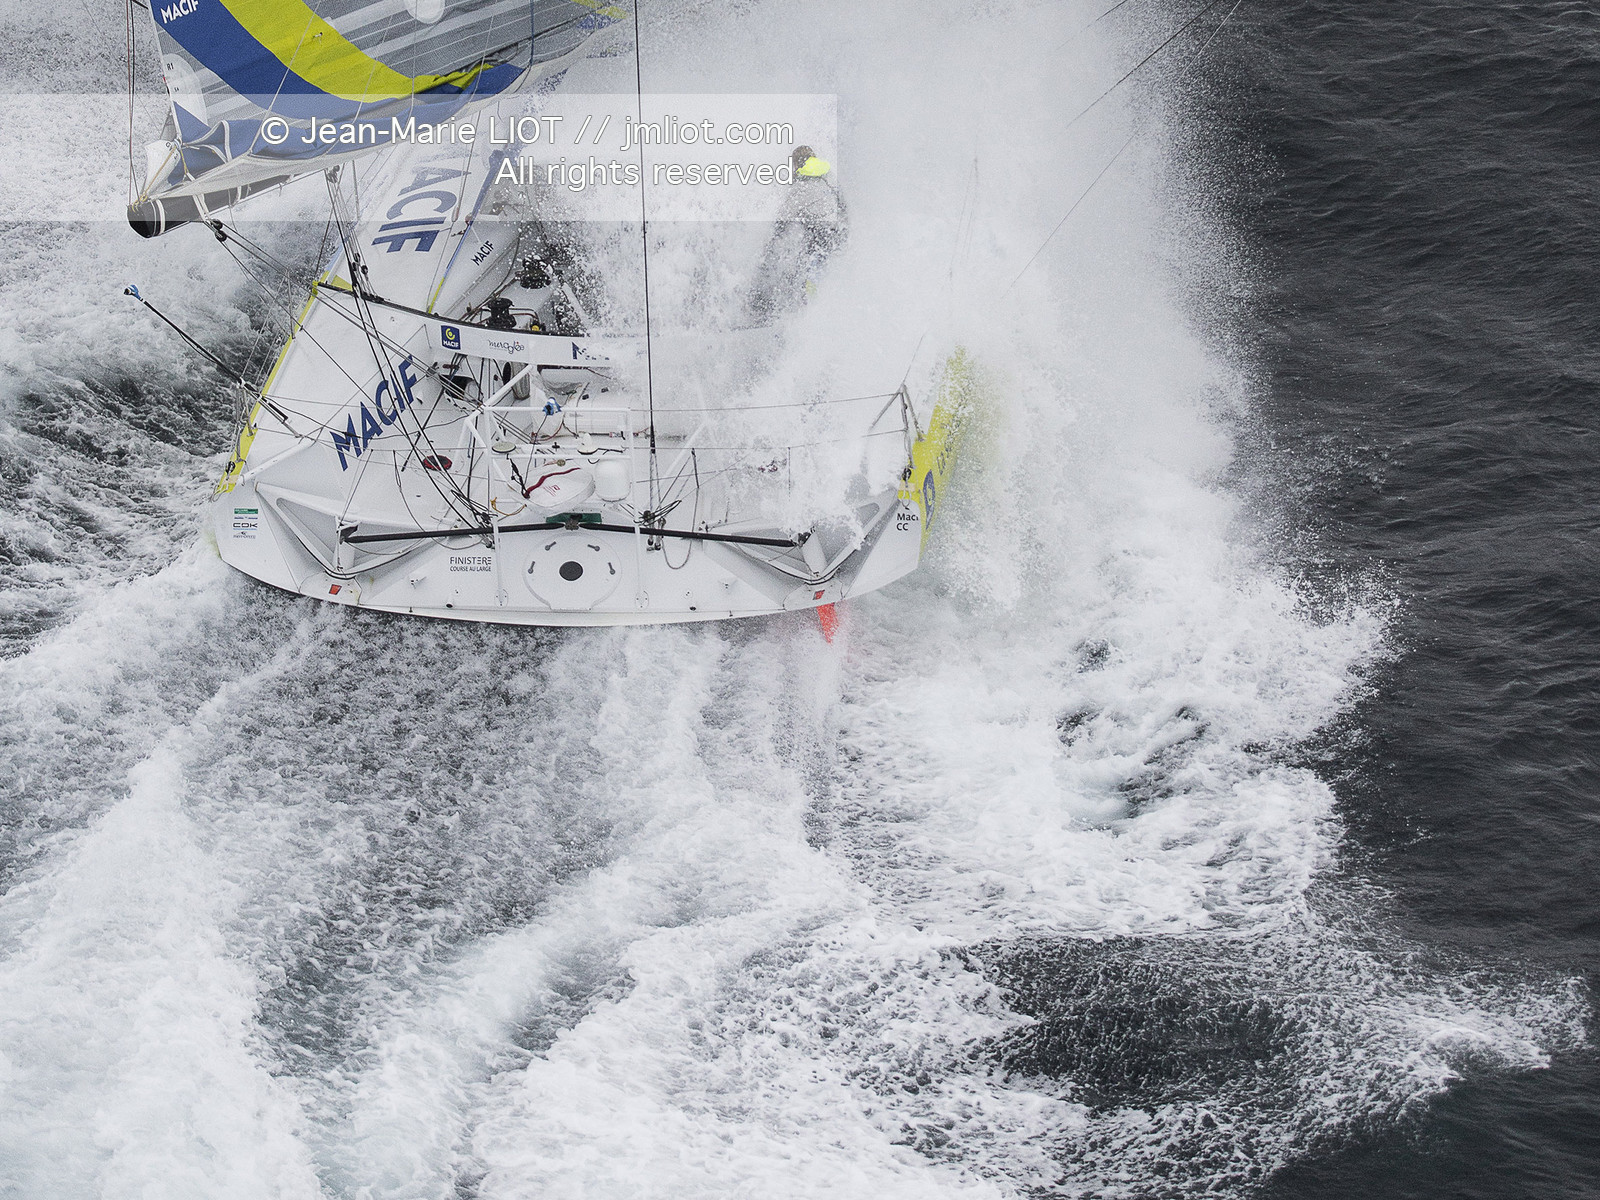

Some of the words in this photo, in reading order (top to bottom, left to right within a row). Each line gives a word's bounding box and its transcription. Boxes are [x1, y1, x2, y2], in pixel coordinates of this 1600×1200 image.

[371, 154, 474, 253] ACIF
[471, 240, 495, 267] MACIF
[329, 354, 417, 472] MACIF
